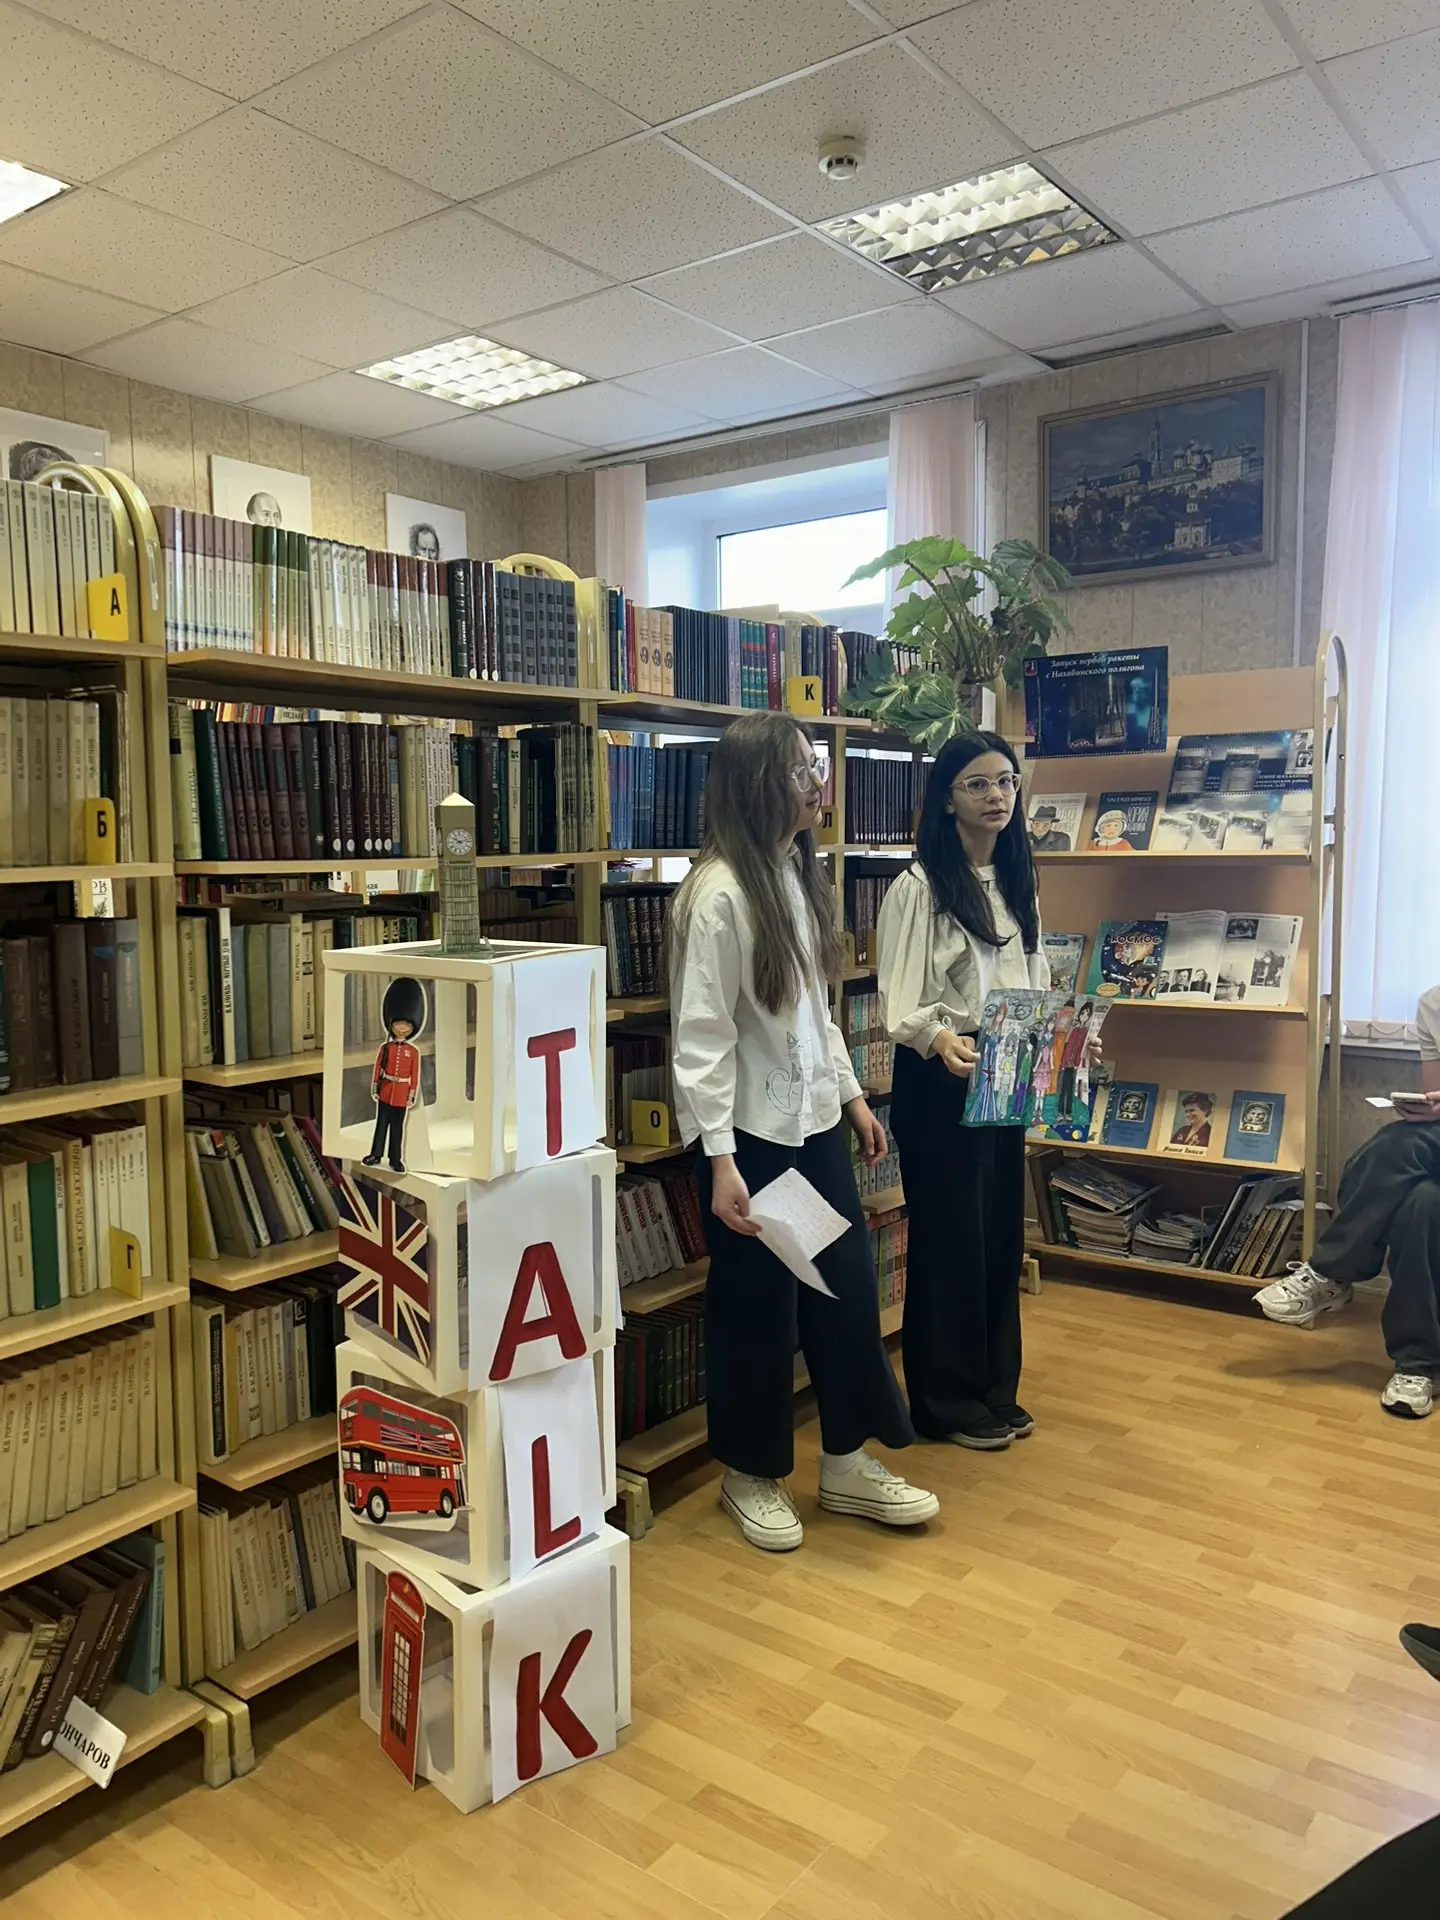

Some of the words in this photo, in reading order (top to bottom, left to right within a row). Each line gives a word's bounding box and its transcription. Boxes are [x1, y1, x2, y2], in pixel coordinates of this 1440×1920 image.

[110, 588, 121, 616] А
[1050, 659, 1077, 668] Запуск
[1079, 655, 1106, 665] первой
[1107, 653, 1140, 664] ракеты
[1107, 664, 1145, 674] полигона
[804, 683, 815, 701] К
[97, 810, 107, 838] Б
[822, 812, 832, 828] Л
[1110, 934, 1161, 945] КОСМОС
[650, 1109, 661, 1129] О
